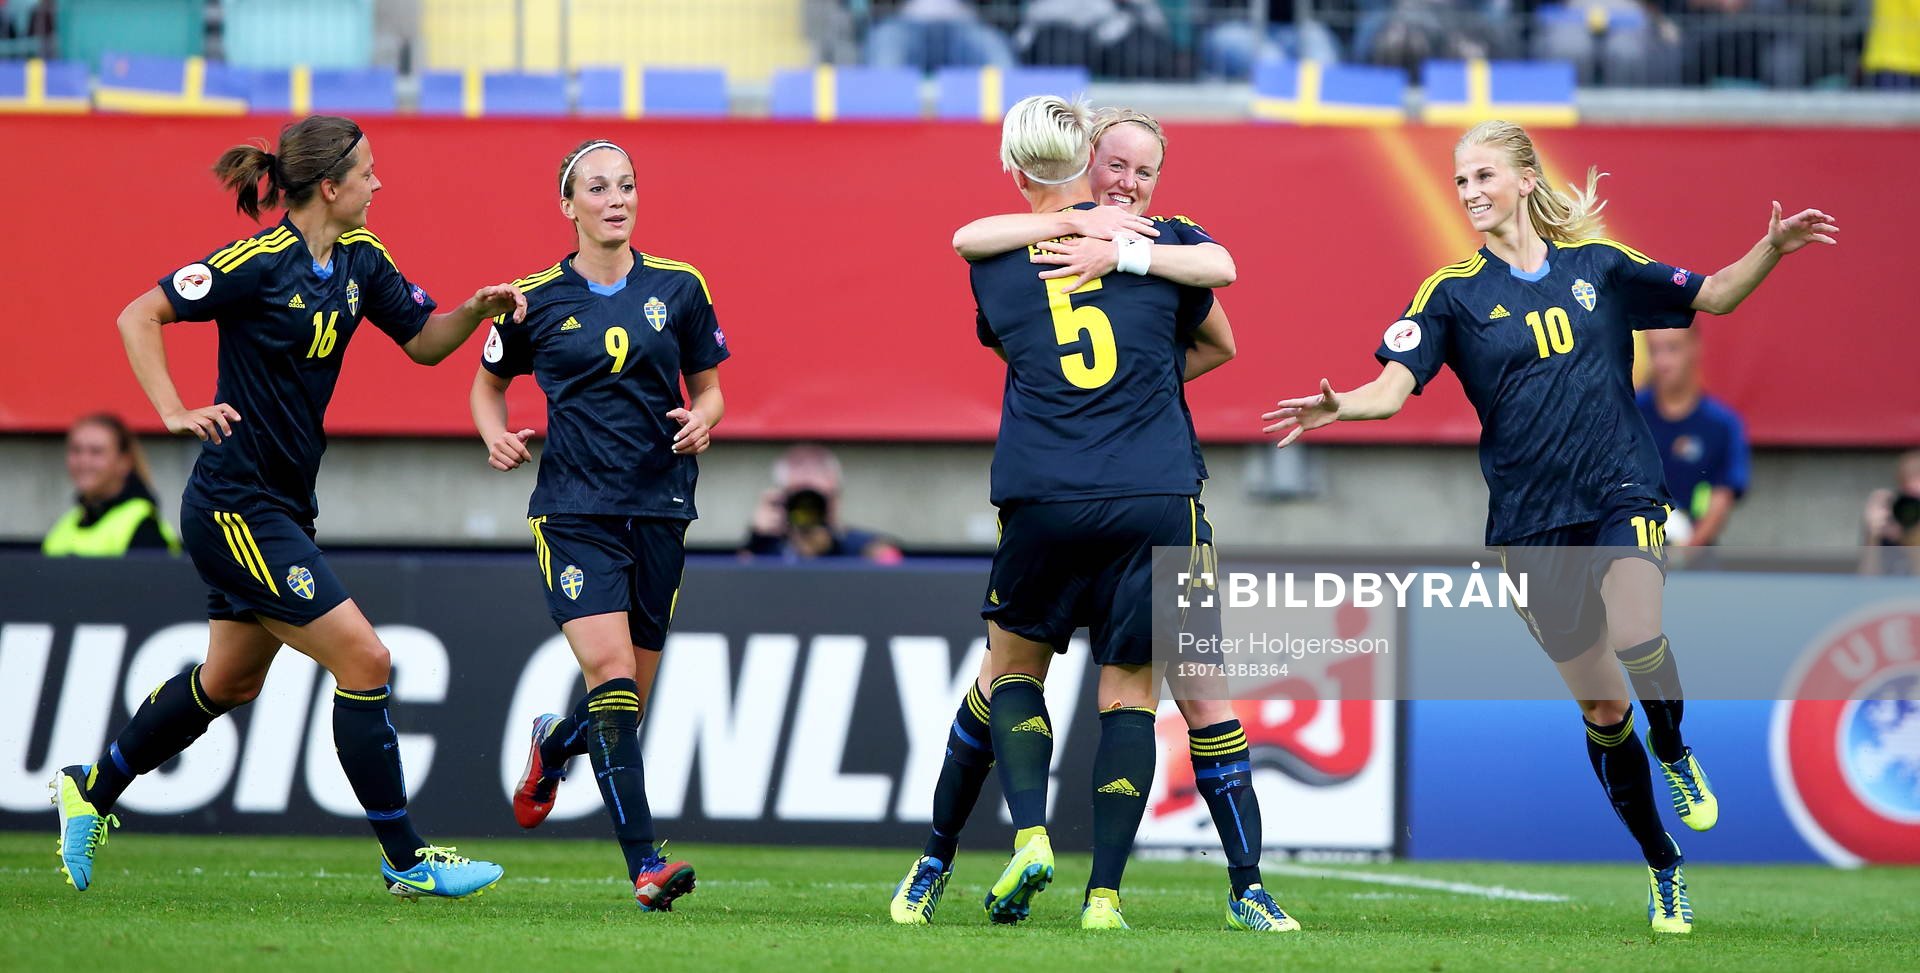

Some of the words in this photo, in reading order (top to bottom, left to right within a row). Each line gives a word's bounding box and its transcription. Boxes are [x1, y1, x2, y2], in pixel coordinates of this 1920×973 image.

[306, 310, 339, 359] 16
[604, 326, 629, 374] 9
[1045, 275, 1118, 390] 5
[1525, 306, 1575, 359] 10
[1011, 724, 1053, 739] adidas
[1097, 786, 1141, 798] adidas
